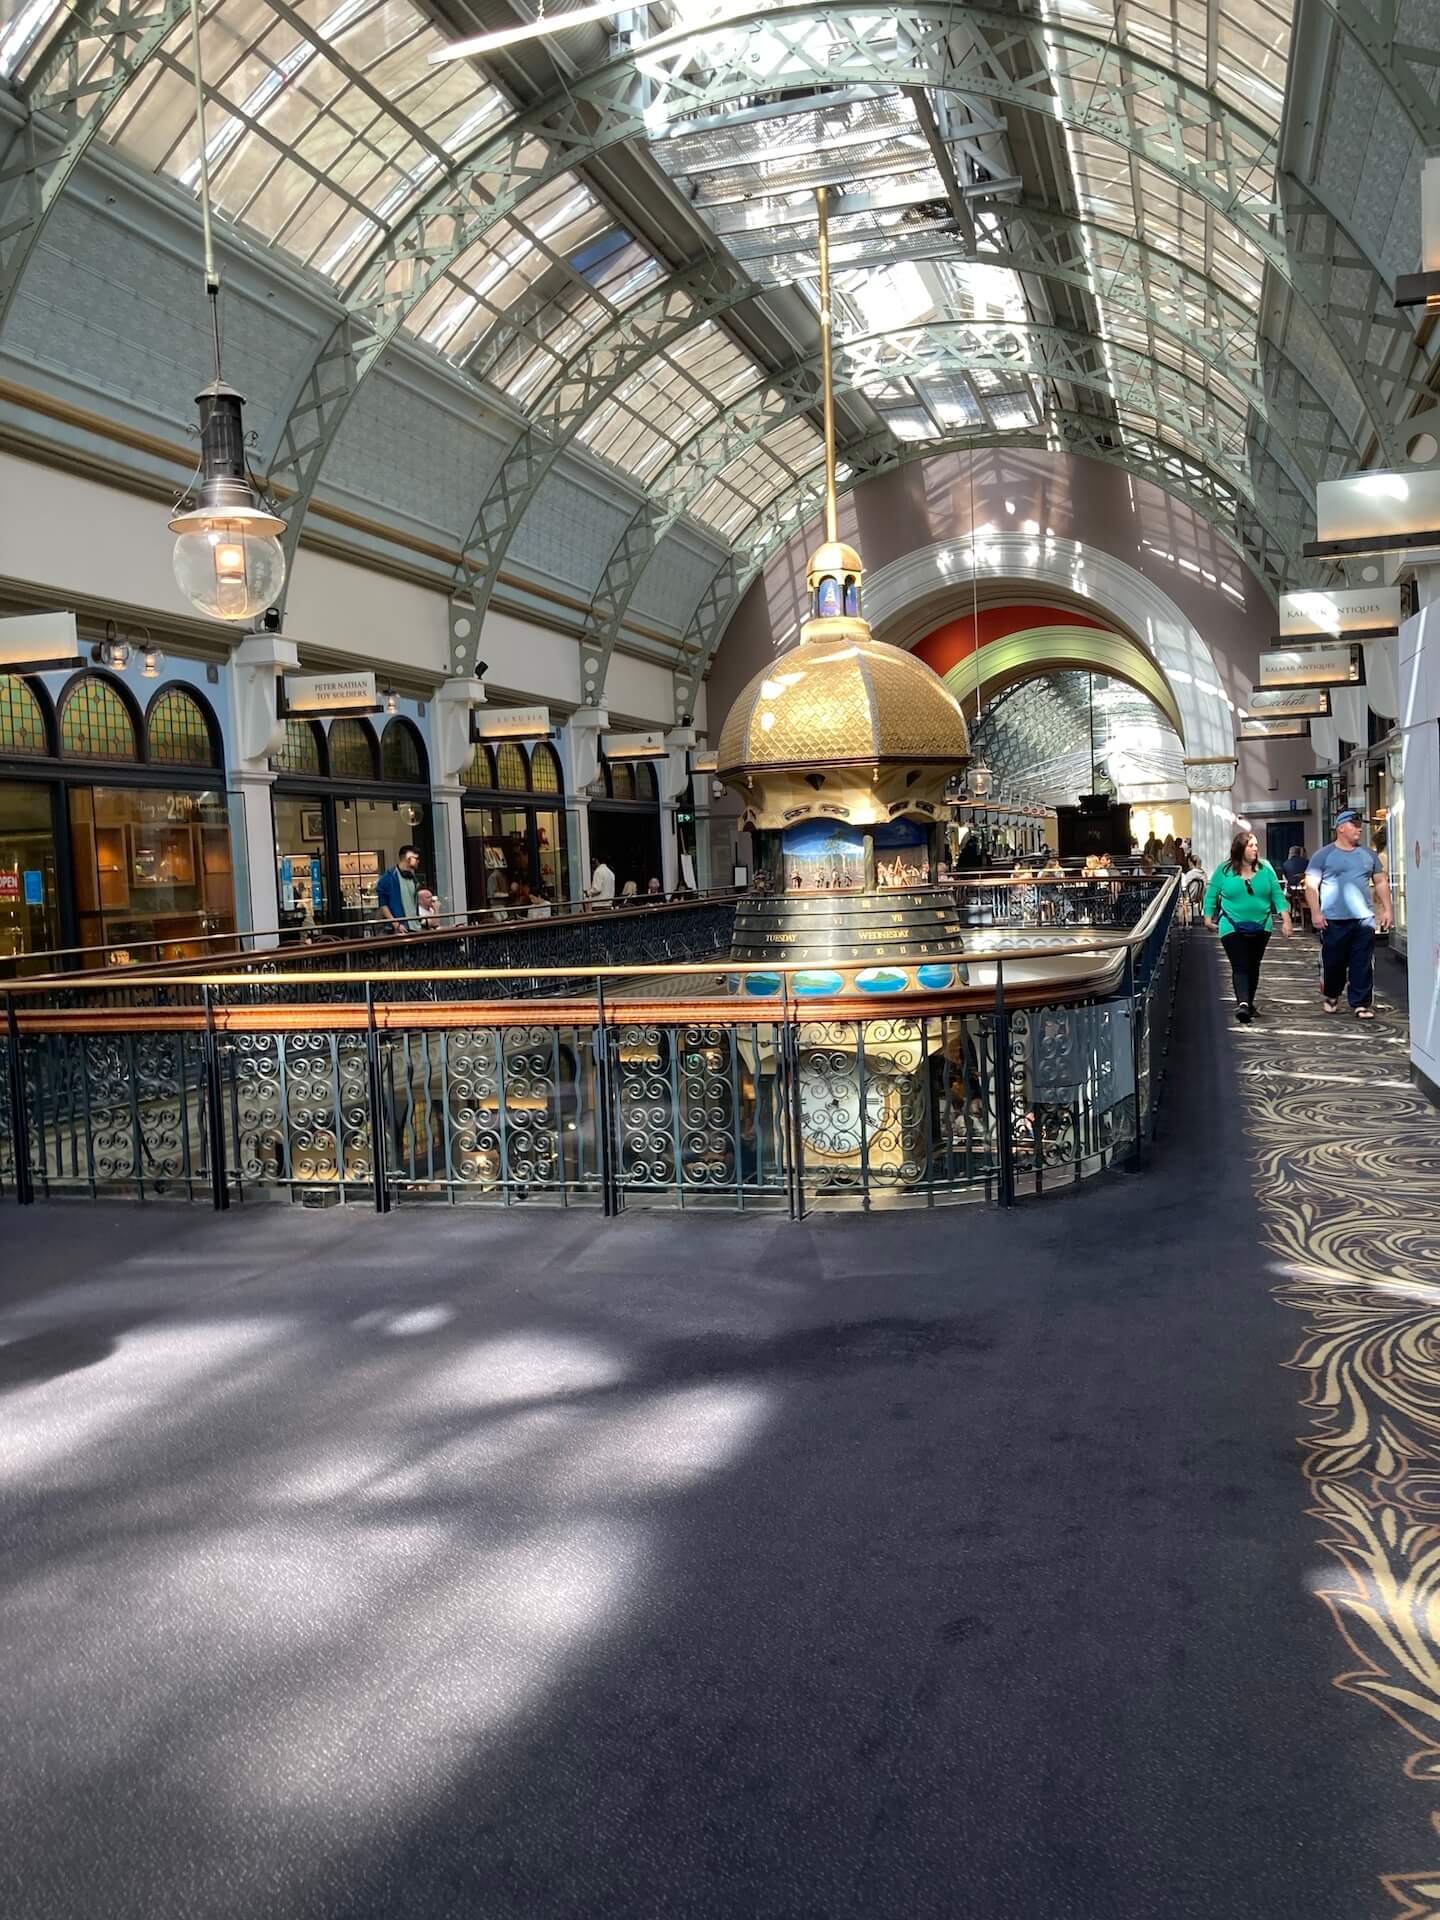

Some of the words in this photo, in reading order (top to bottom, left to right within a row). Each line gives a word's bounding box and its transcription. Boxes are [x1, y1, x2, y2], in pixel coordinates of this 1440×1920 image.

[1297, 663, 1336, 671] ANTIQUES
[314, 682, 337, 691] PETER
[337, 680, 368, 690] NATHAN
[317, 692, 331, 700] TOY
[332, 689, 368, 699] SOLDIERS
[766, 934, 797, 943] TUESDAY
[858, 929, 910, 940] WEDNESDAY
